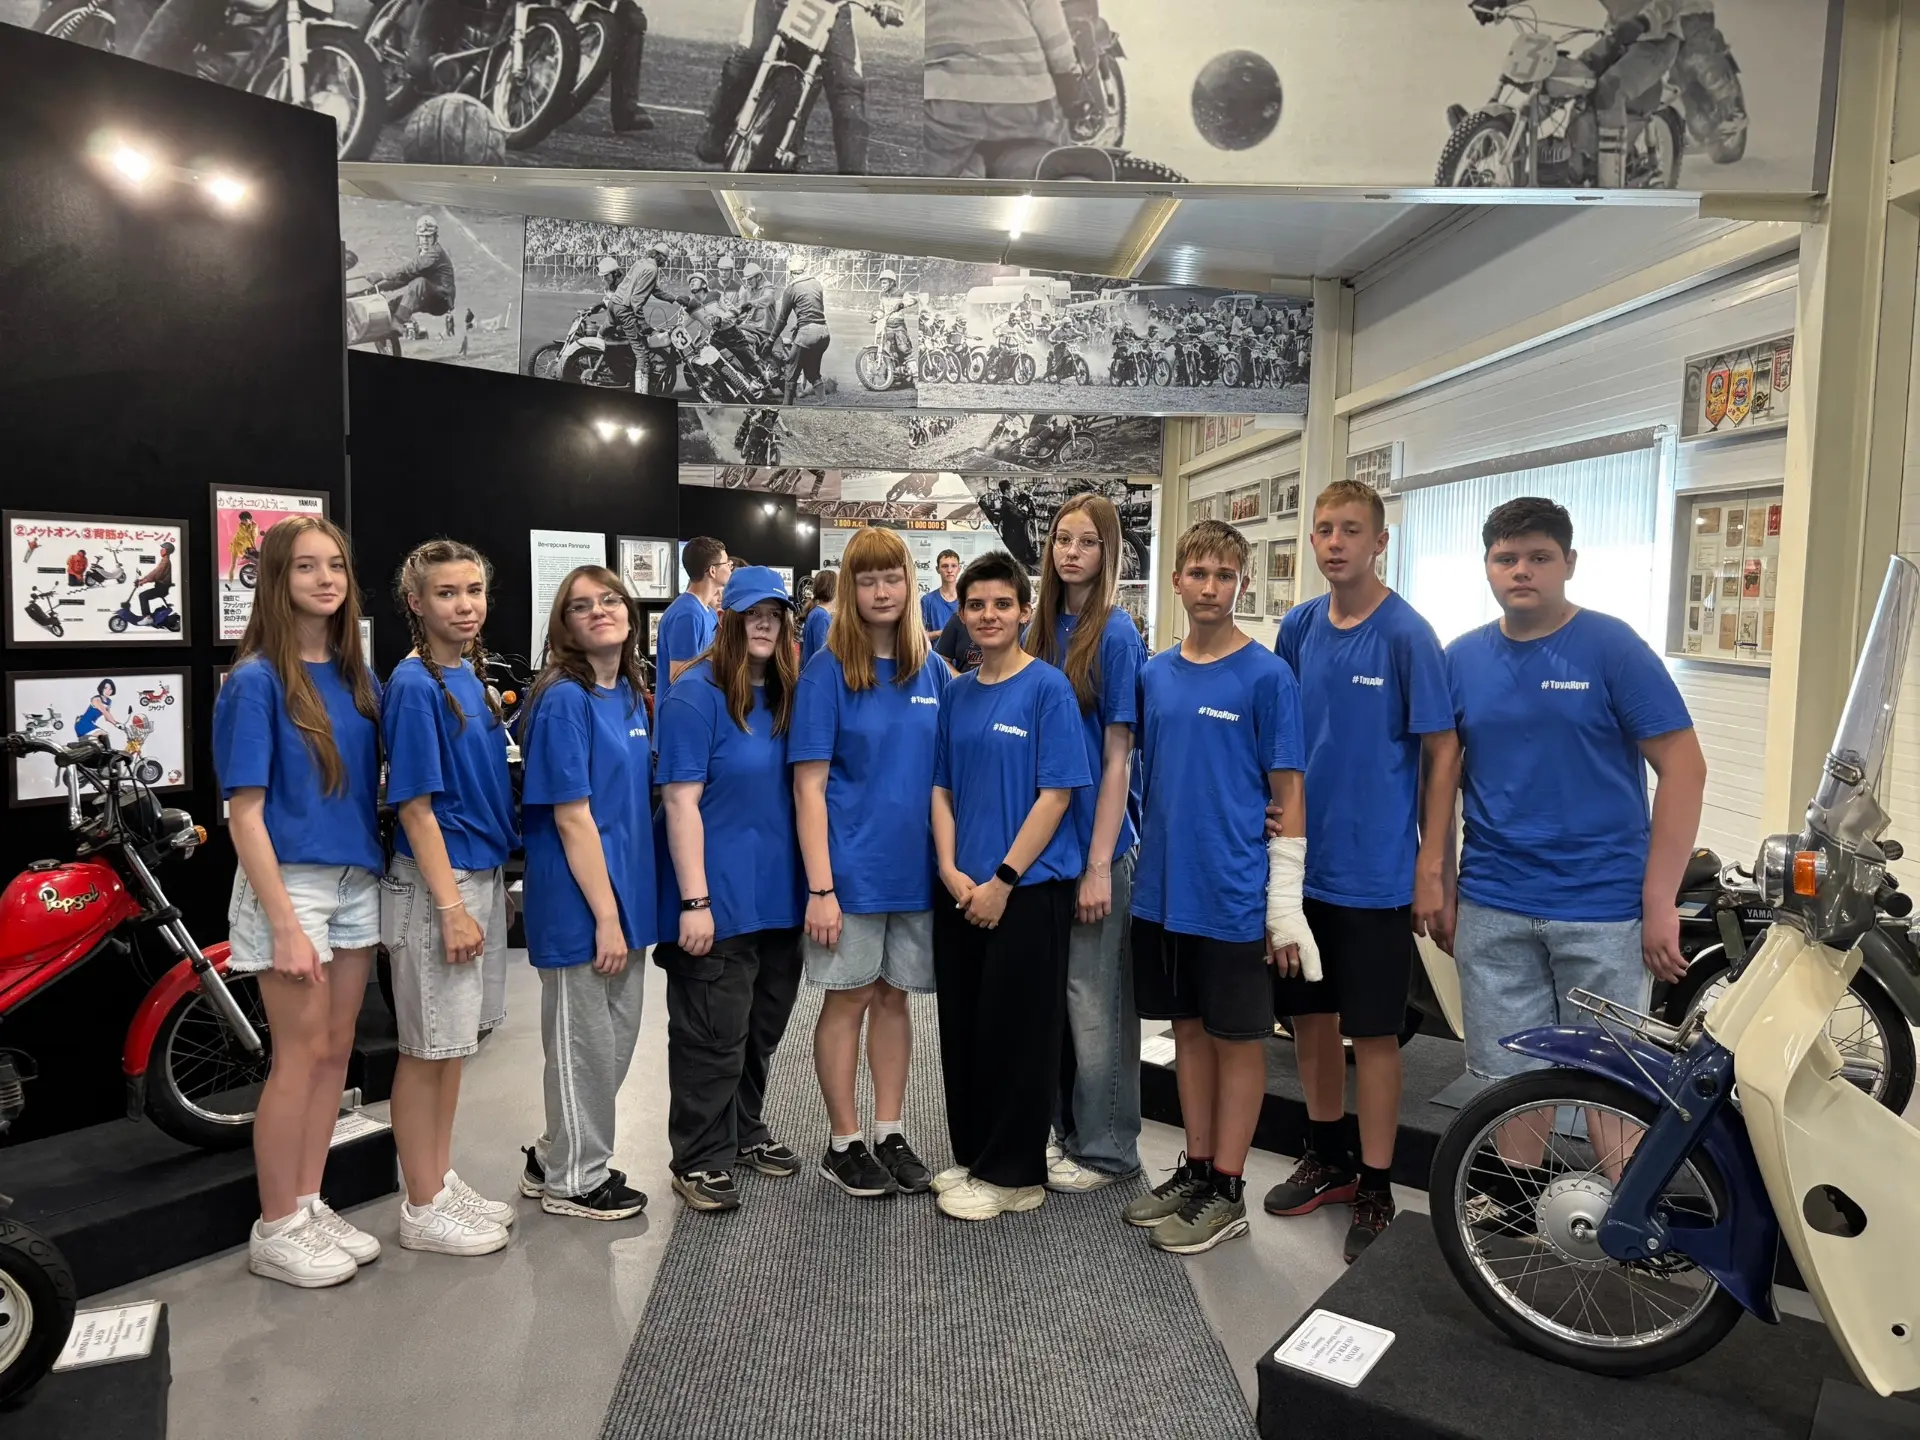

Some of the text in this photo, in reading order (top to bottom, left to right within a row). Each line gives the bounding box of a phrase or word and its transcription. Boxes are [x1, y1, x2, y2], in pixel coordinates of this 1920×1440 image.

[298, 499, 318, 507] YAMAHA
[537, 541, 568, 549] Венгерская
[1747, 908, 1773, 919] YAMA
